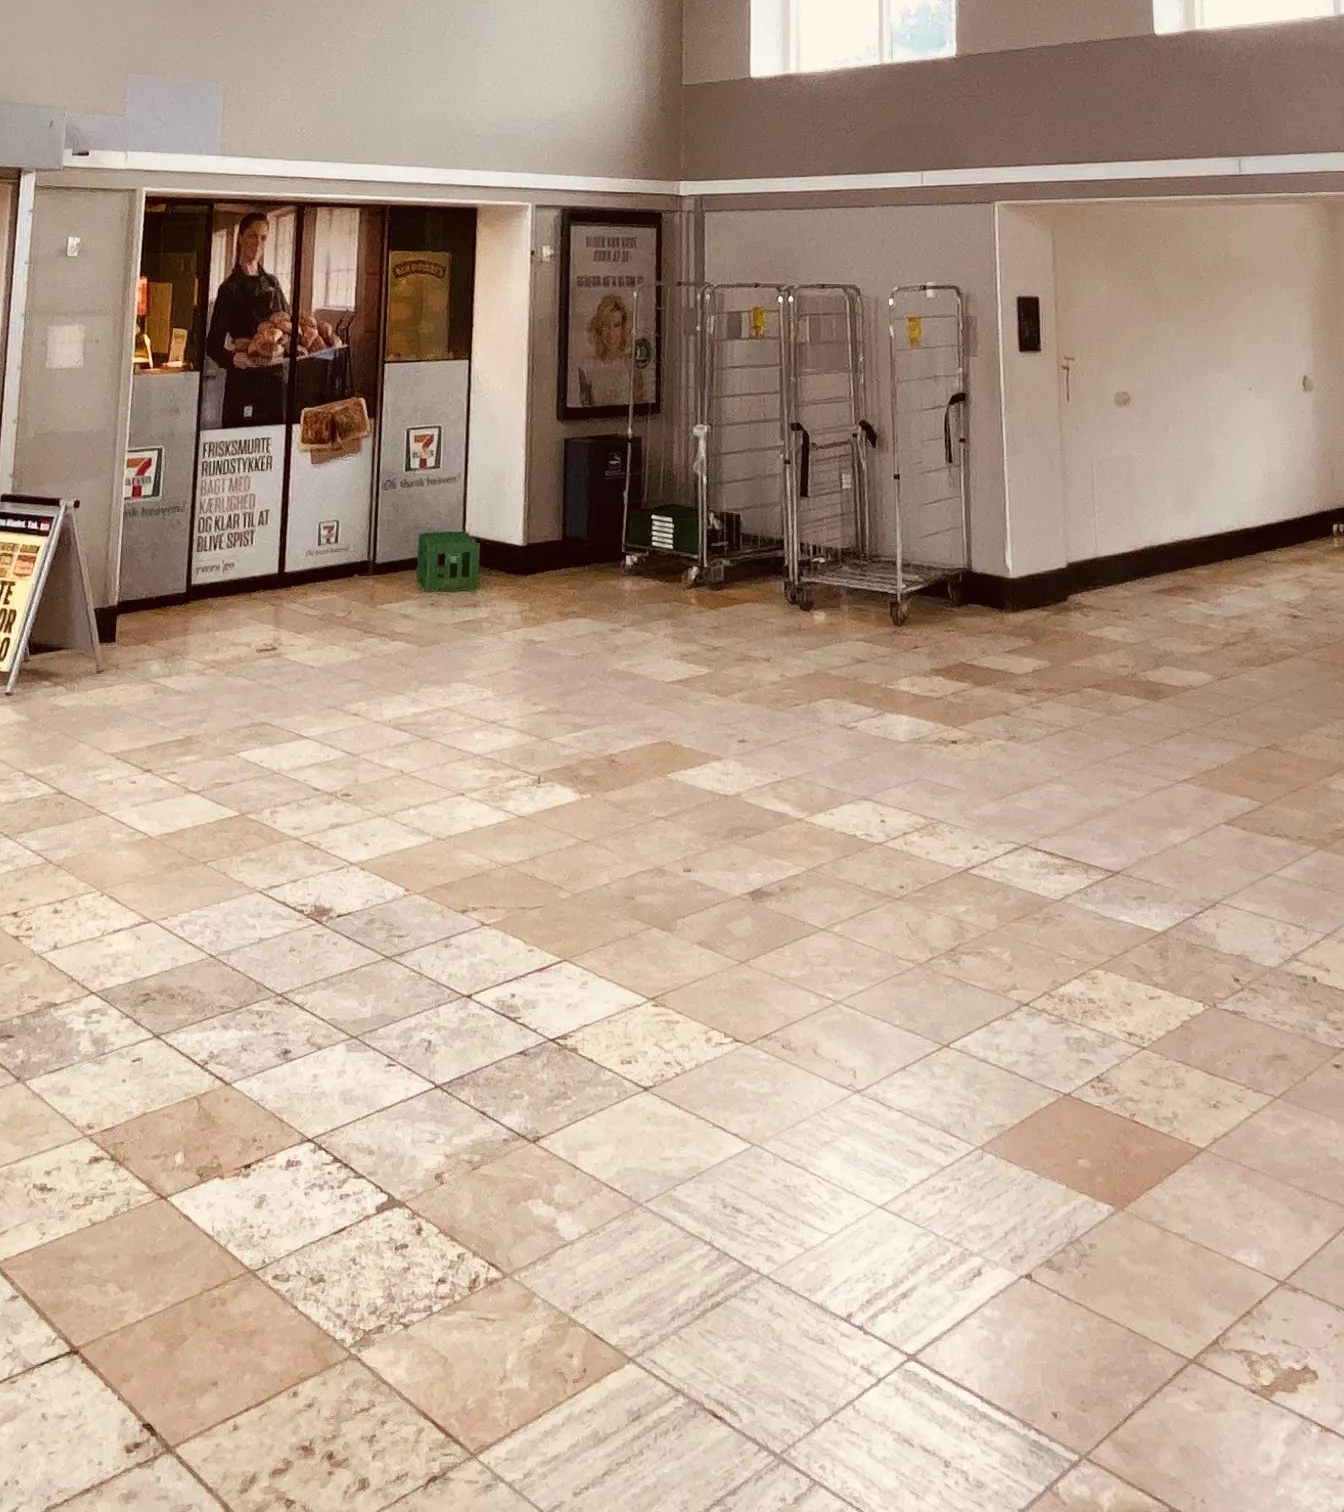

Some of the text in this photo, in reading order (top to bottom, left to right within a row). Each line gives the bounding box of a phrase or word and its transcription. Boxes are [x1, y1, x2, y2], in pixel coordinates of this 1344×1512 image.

[202, 437, 272, 458] FRISKSMURTE
[201, 455, 273, 477] RUNDSTYKKER
[200, 476, 251, 496] BAGT MED
[199, 493, 256, 514] KÆRLIGHED
[197, 509, 270, 534] OG KLAR TIL AT
[196, 530, 256, 553] BLIVE SPIST
